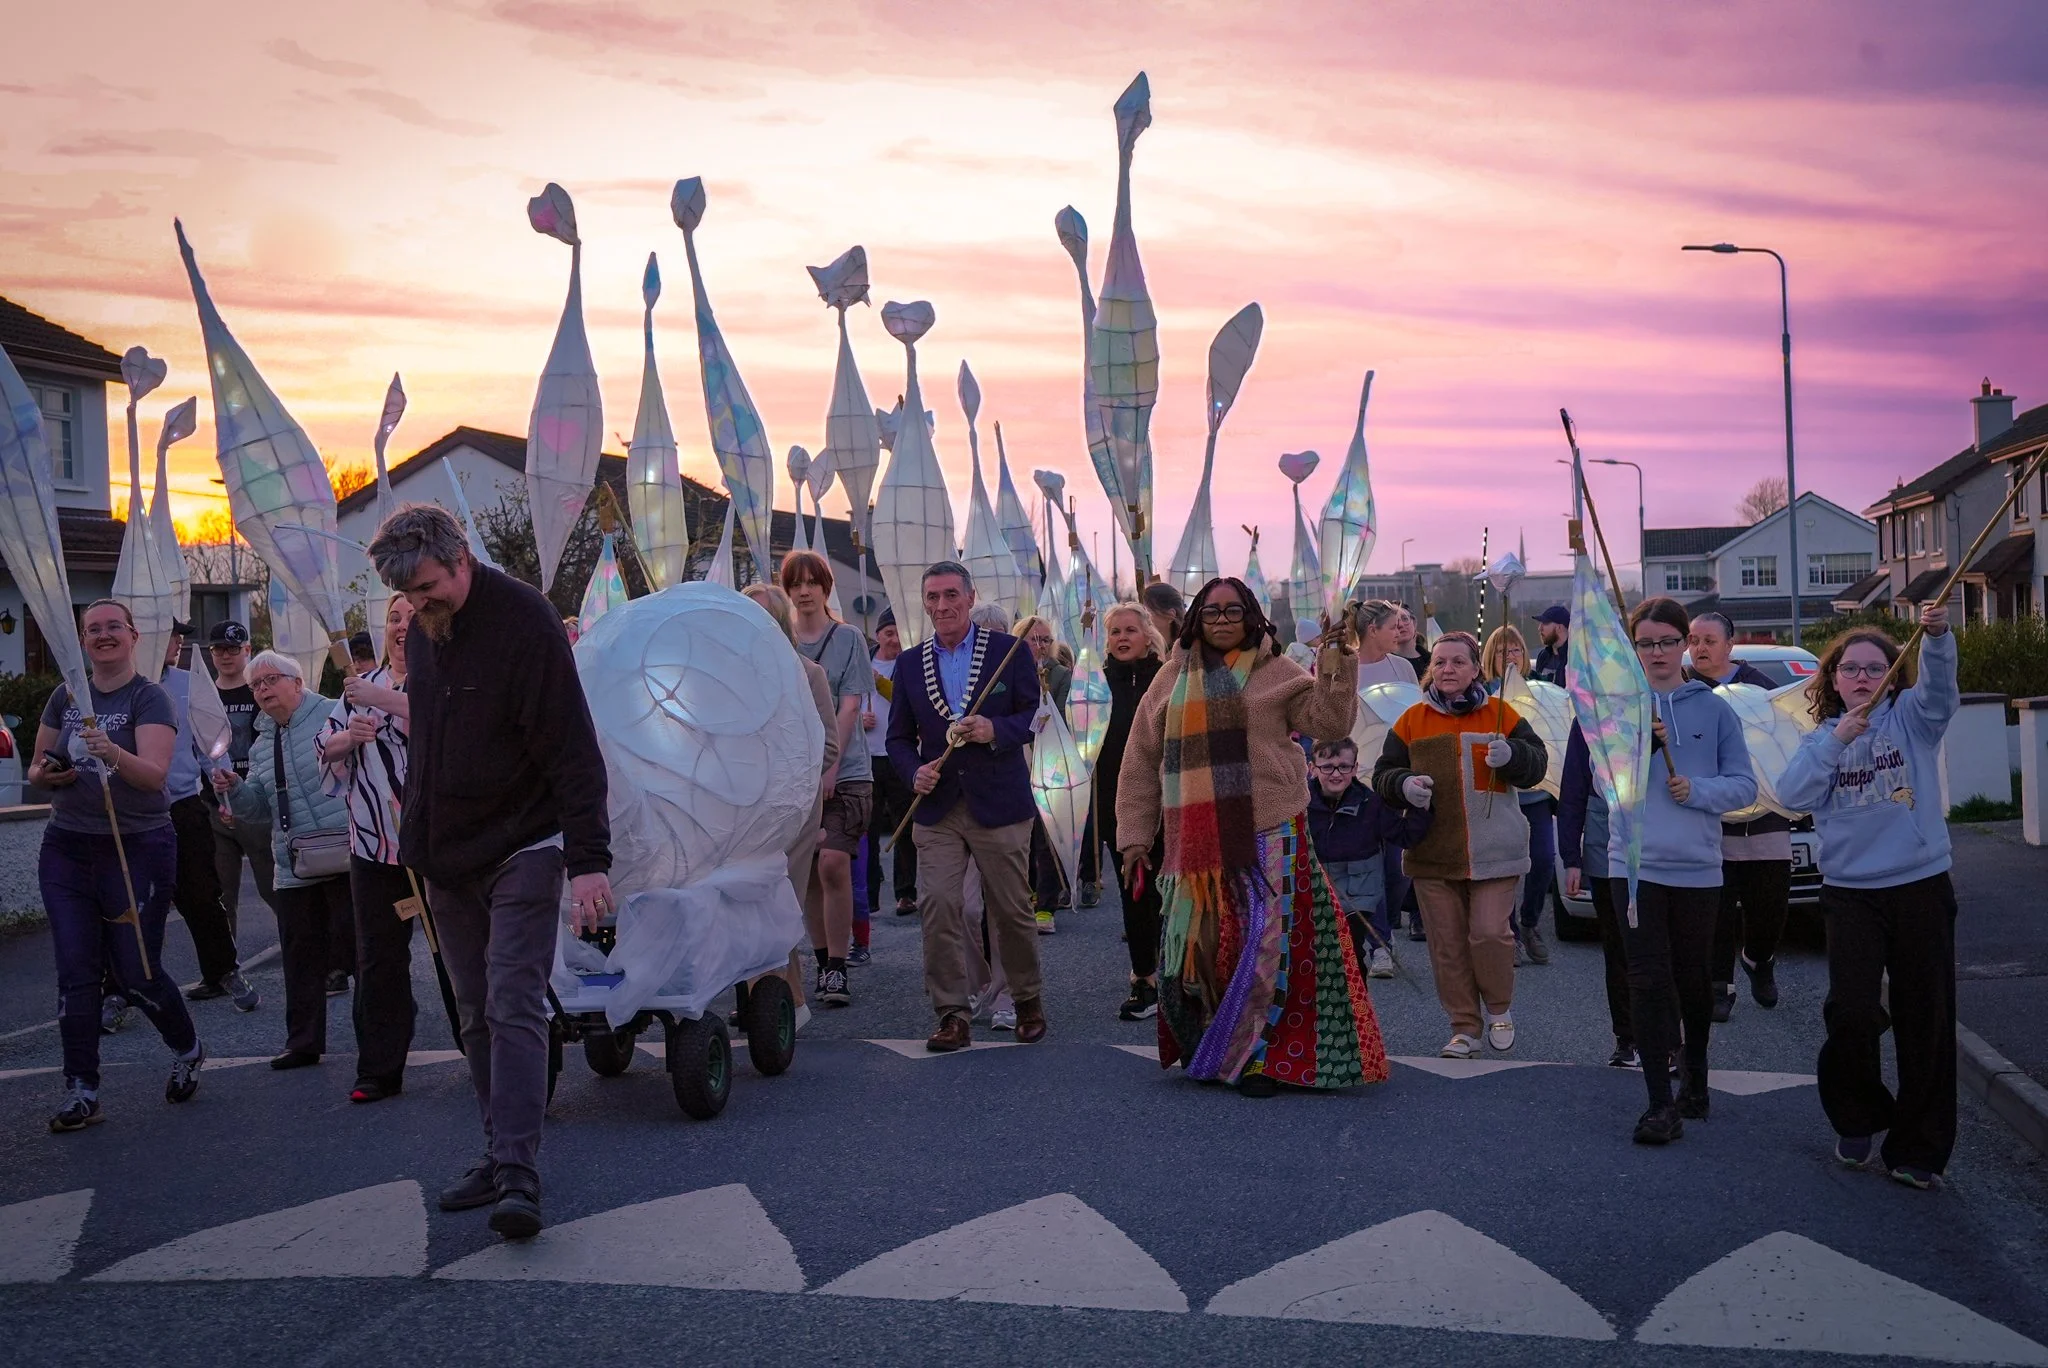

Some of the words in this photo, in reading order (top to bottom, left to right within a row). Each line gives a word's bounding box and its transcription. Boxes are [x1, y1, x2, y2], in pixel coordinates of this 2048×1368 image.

[229, 704, 239, 712] BY
[240, 703, 254, 711] DAY
[63, 709, 128, 724] SOTIMES
[71, 721, 85, 729] TAKE
[107, 723, 120, 731] DAY
[236, 760, 249, 769] NIG
